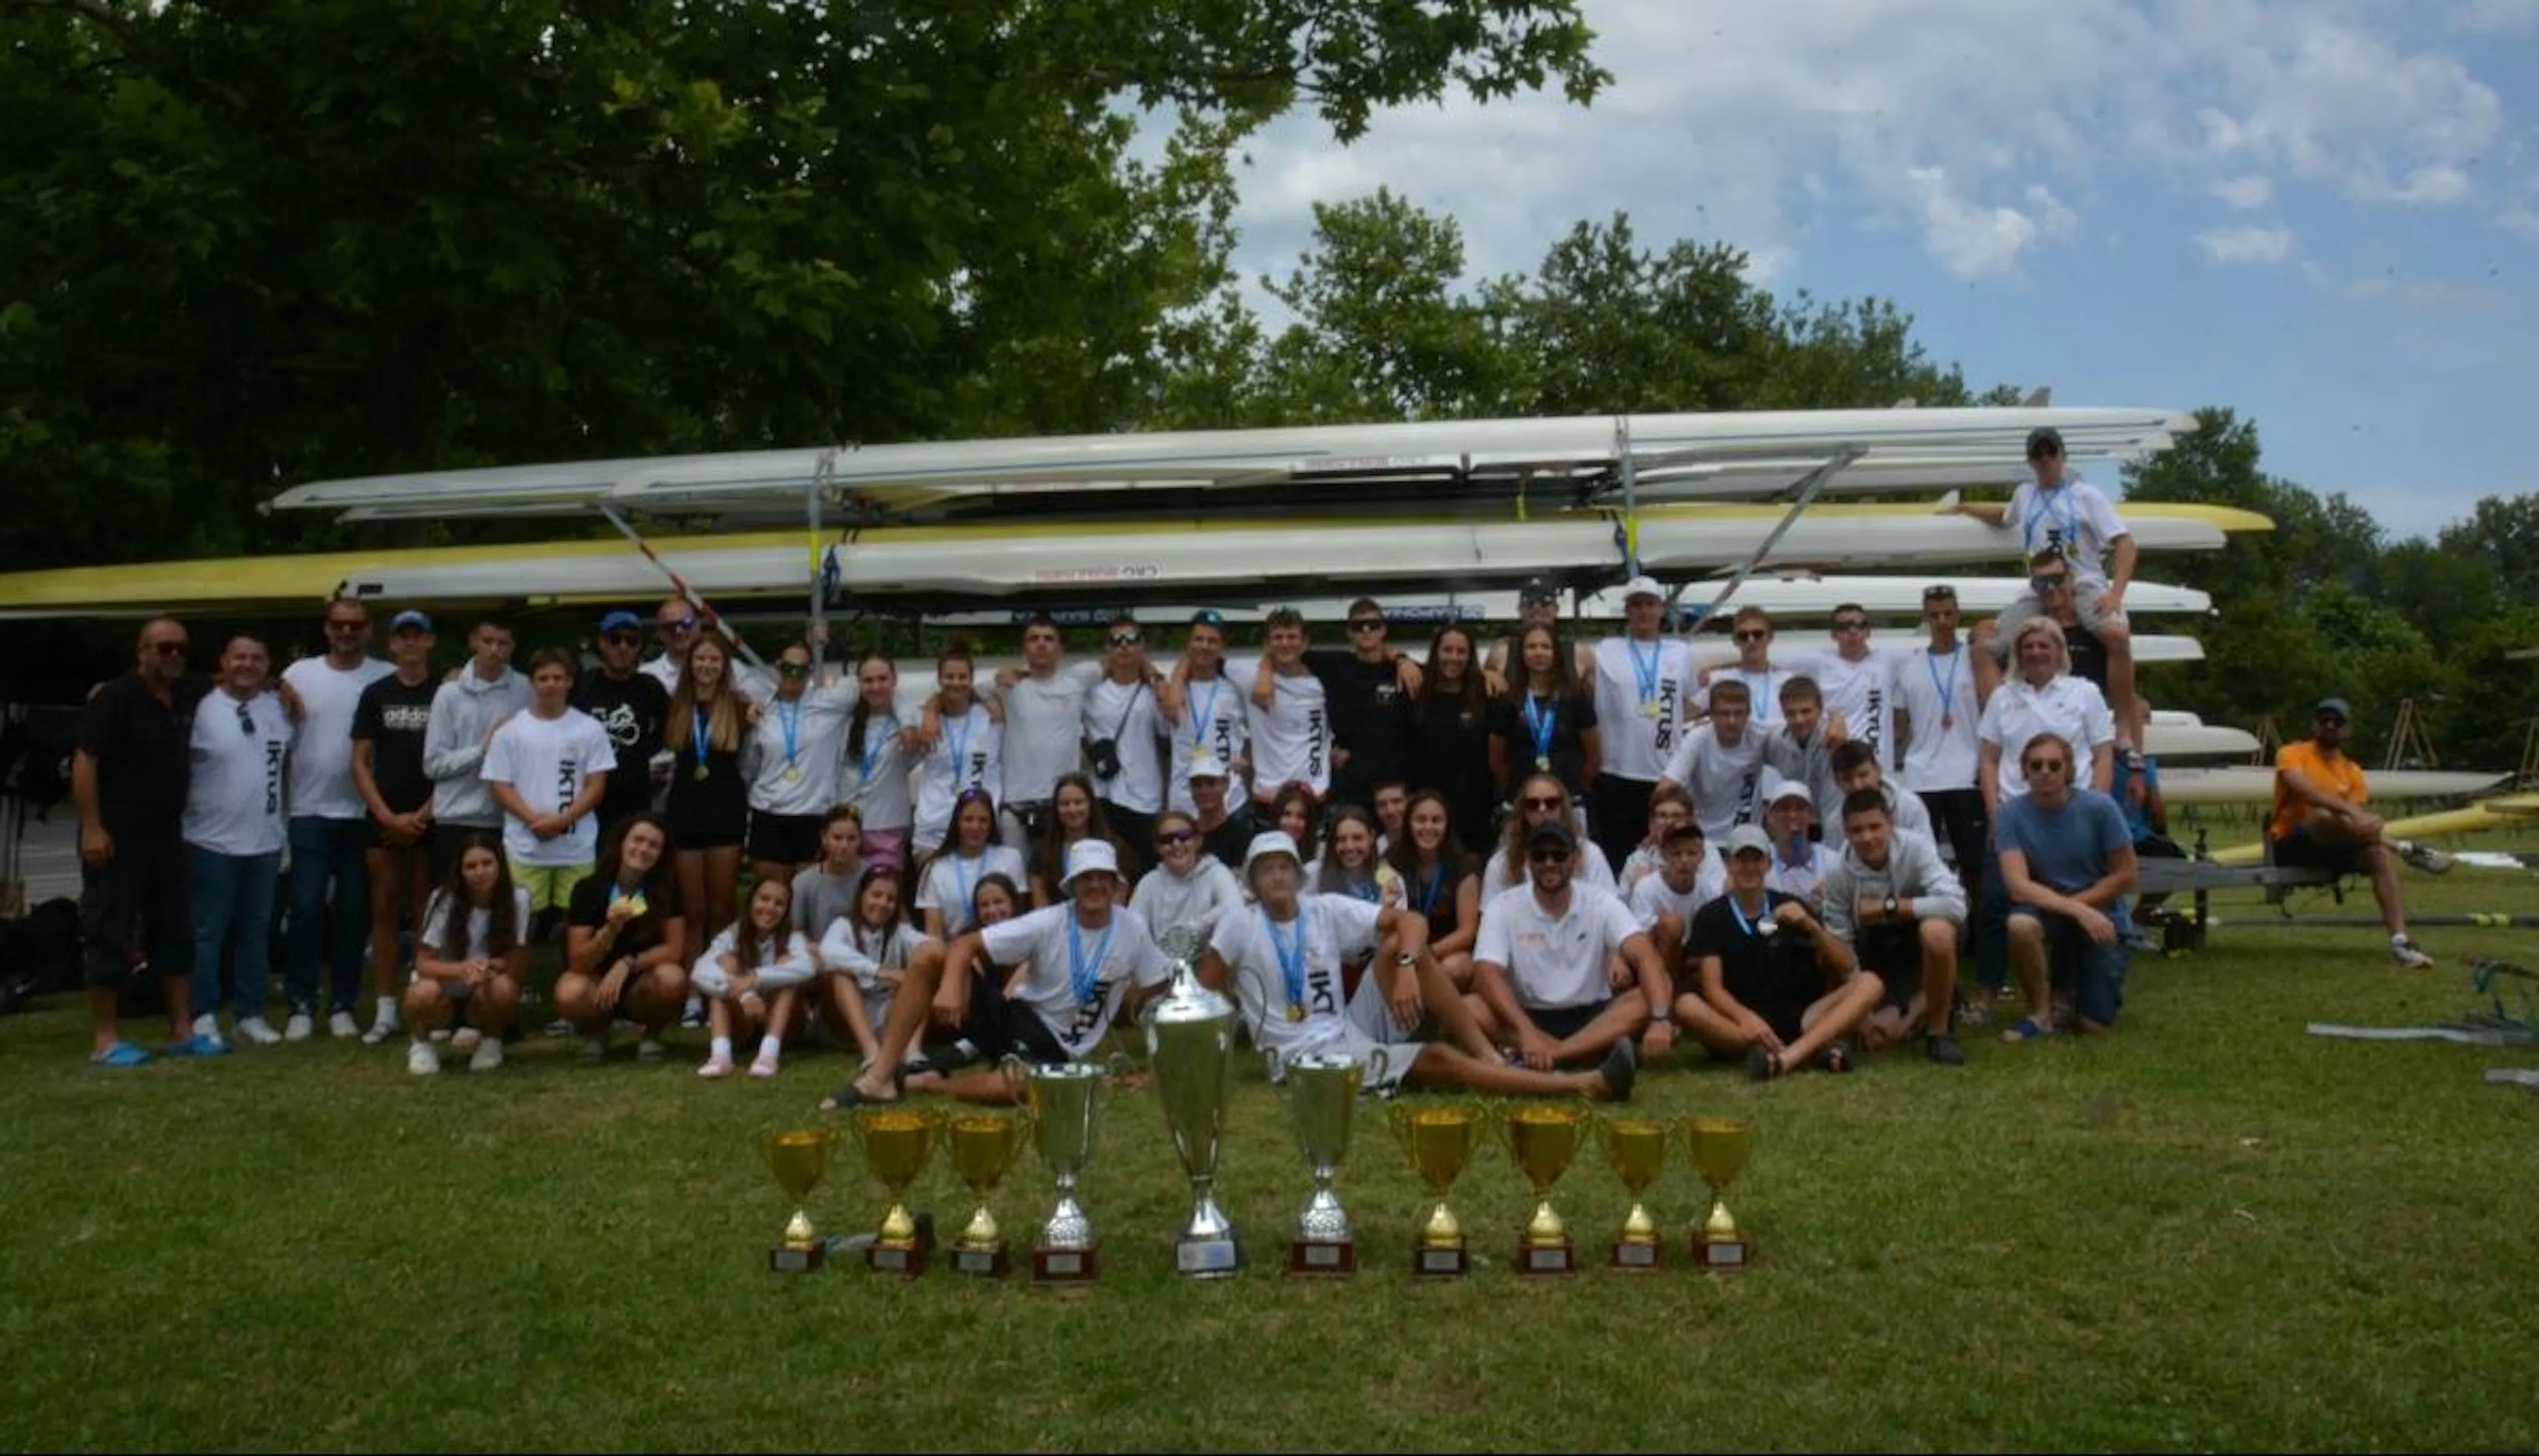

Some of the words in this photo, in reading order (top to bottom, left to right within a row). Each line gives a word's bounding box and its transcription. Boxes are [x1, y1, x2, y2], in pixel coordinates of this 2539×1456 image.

[1309, 709, 1322, 776] IKTUS
[1656, 679, 1677, 749] IKTUS
[266, 741, 281, 814] IKTUS
[559, 760, 575, 834] IKT
